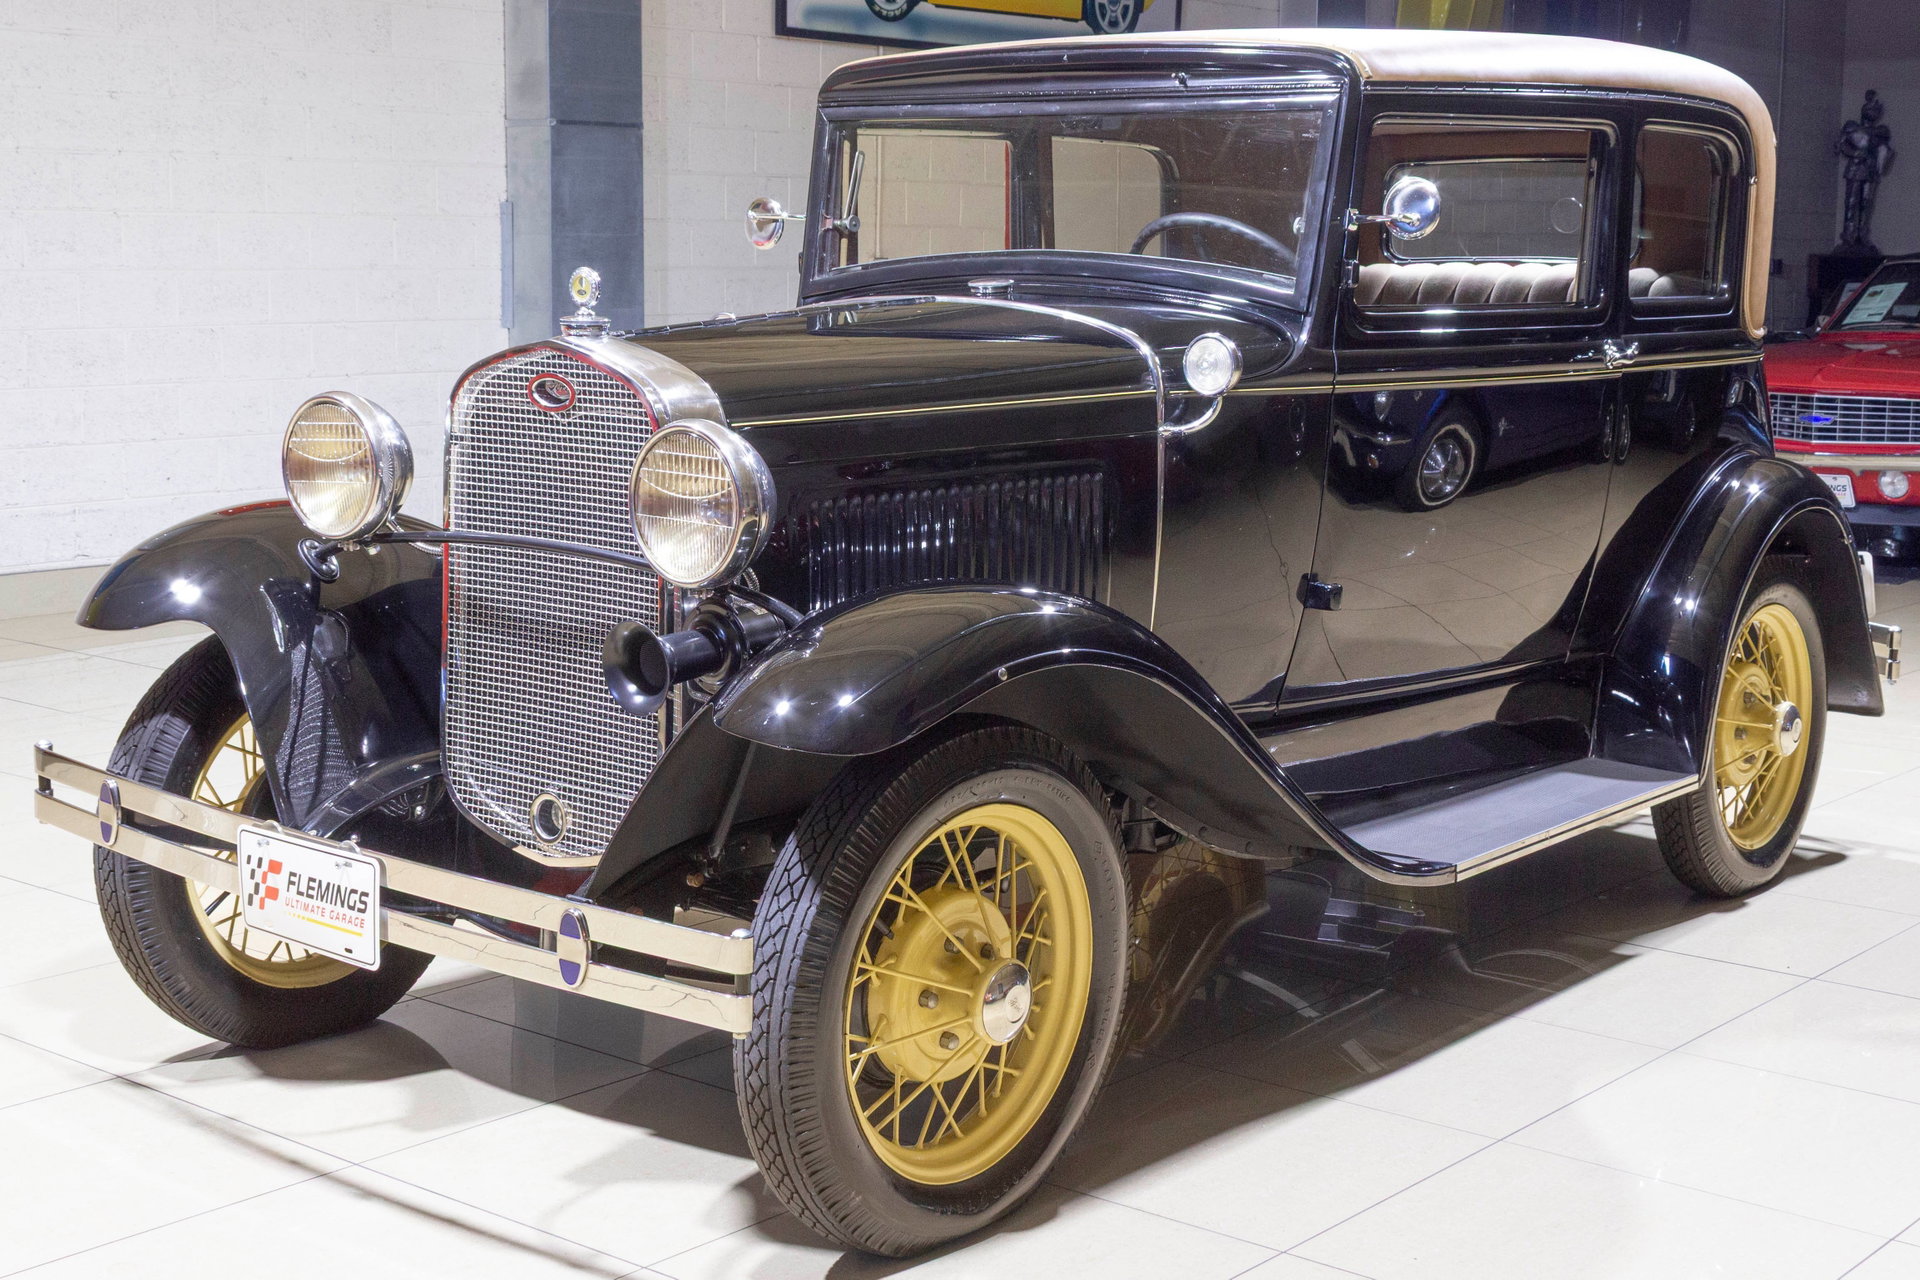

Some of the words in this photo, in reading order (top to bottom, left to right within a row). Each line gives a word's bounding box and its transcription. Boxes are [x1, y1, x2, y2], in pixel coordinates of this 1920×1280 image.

[286, 871, 370, 914] FLEMINGS
[284, 896, 326, 917] ULTIMATE
[329, 910, 365, 929] GARAGE
